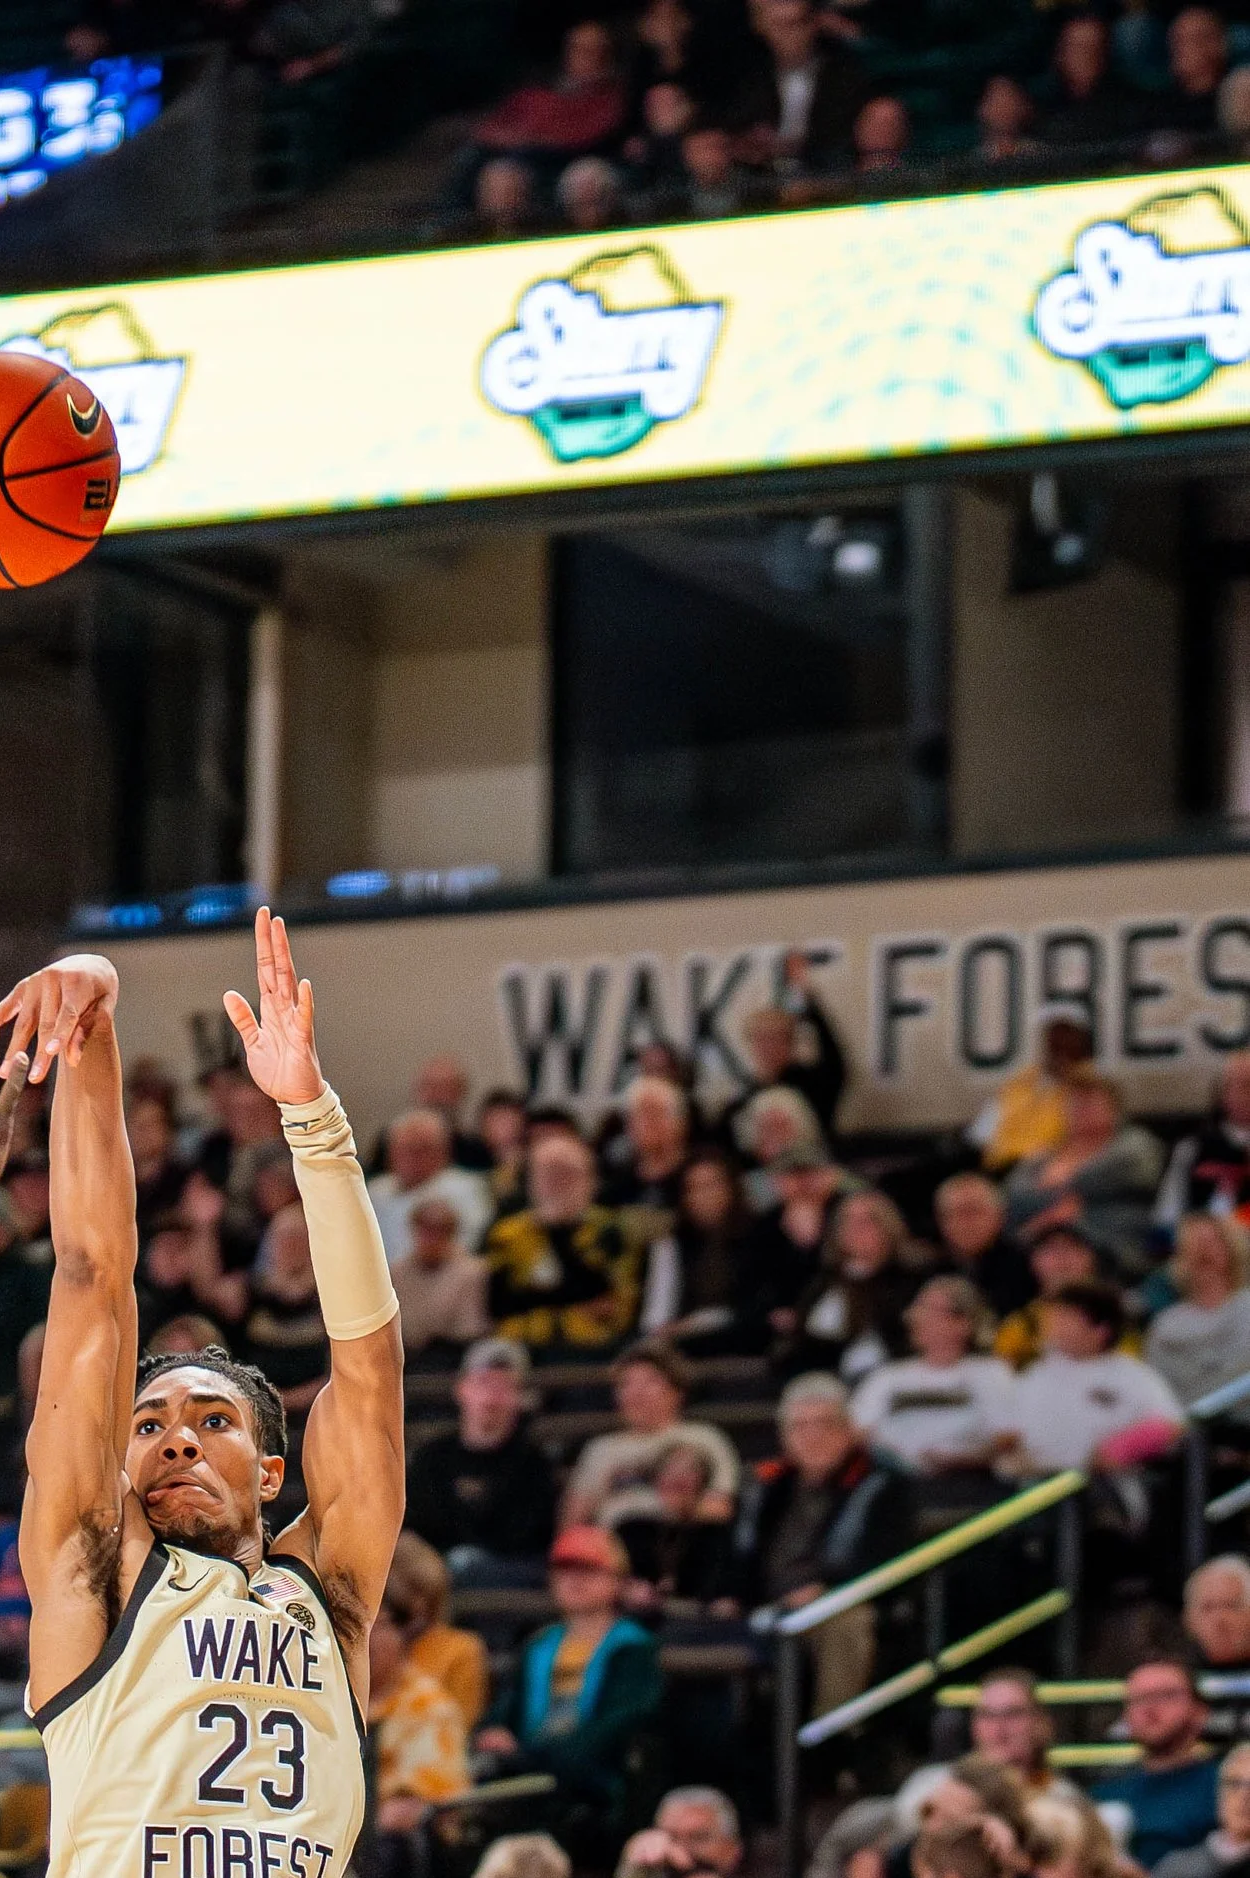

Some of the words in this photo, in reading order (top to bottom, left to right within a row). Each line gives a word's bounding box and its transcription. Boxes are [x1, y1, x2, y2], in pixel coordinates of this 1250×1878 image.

[502, 940, 843, 1100] WAK
[183, 1617, 324, 1692] WAKE
[197, 1702, 309, 1814] 23
